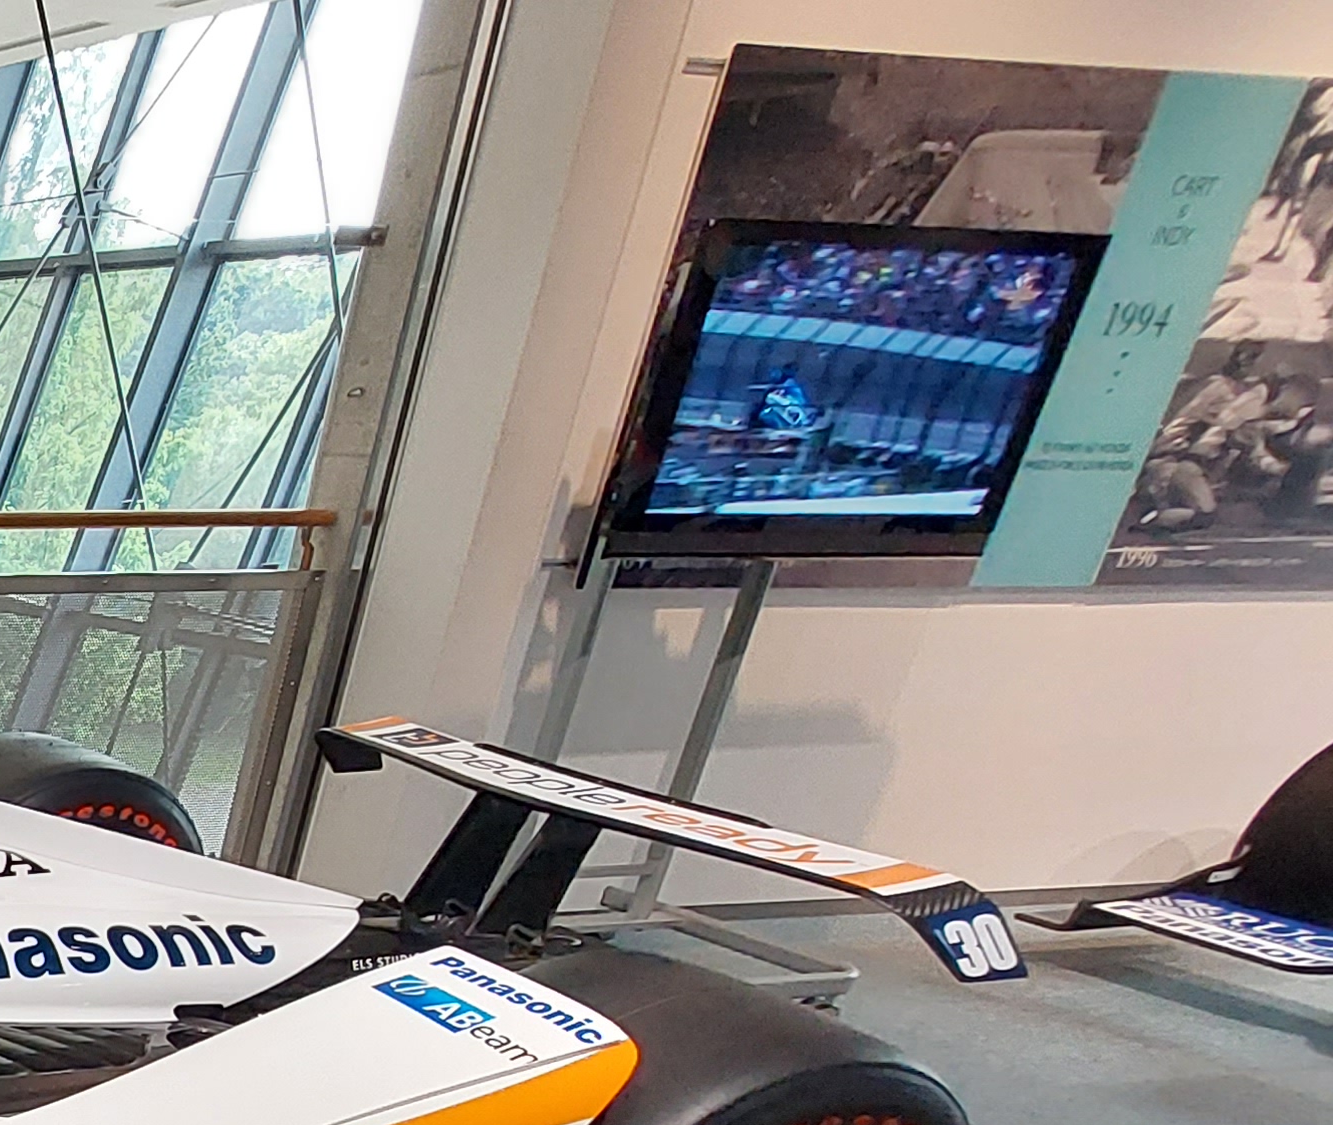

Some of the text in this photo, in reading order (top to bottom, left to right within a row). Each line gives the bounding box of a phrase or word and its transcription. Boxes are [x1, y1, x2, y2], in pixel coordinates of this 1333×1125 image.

[1103, 302, 1175, 338] 1994
[352, 957, 374, 972] ELS
[943, 912, 1018, 979] 30
[430, 956, 602, 1044] Panasonic
[422, 1001, 539, 1064] ABeam
